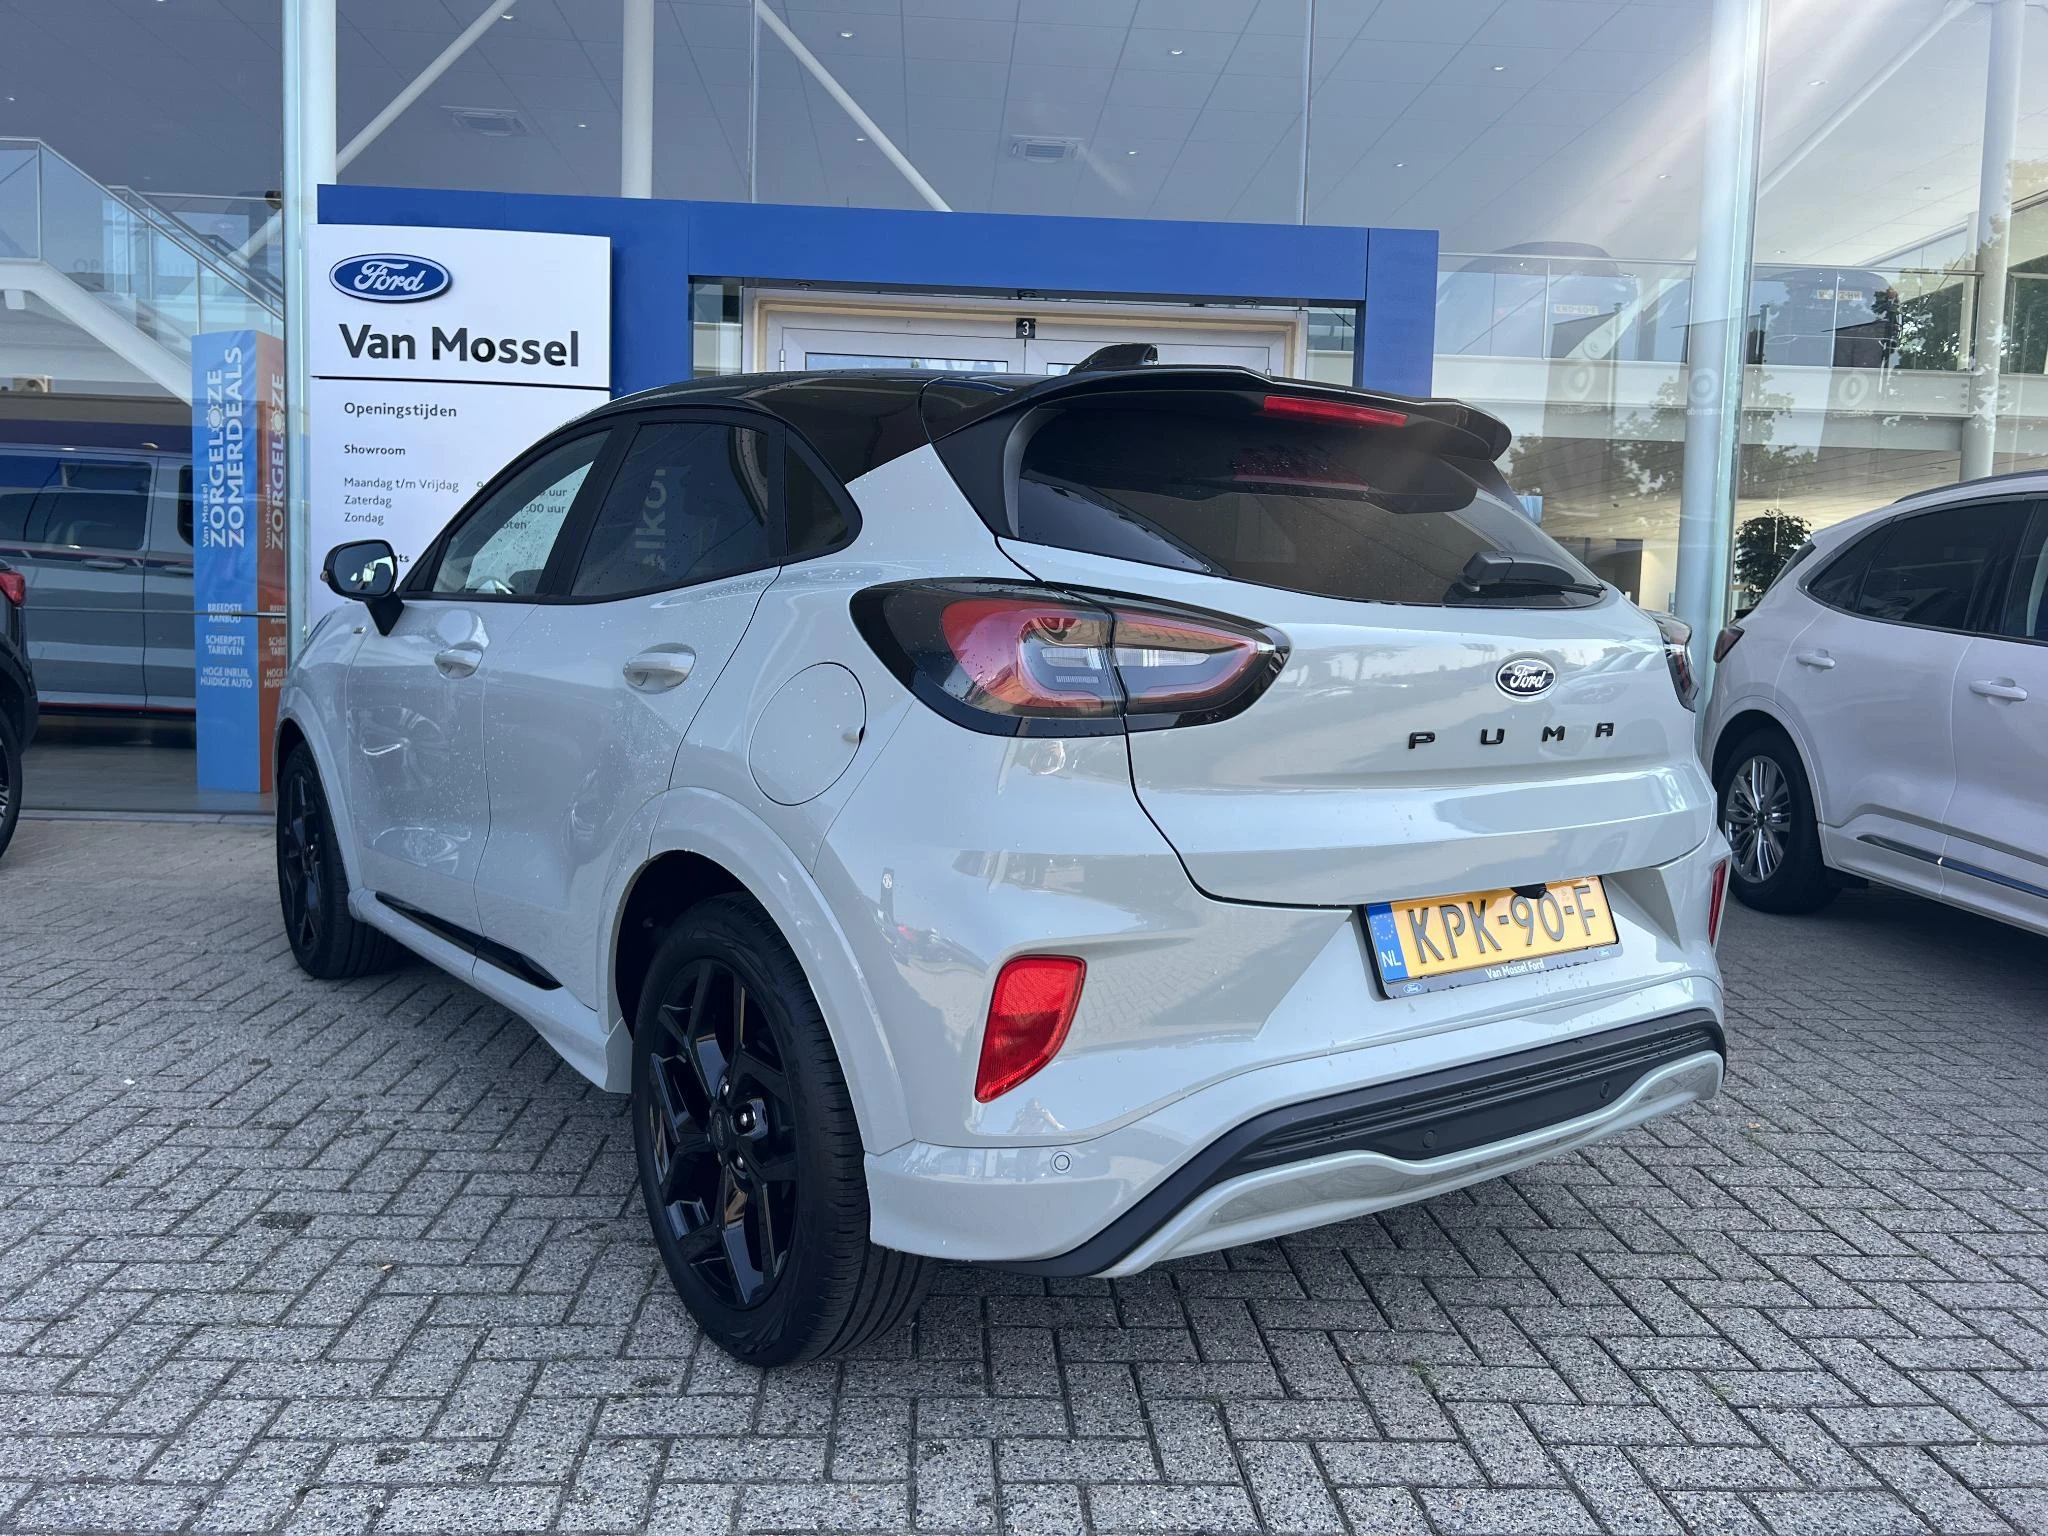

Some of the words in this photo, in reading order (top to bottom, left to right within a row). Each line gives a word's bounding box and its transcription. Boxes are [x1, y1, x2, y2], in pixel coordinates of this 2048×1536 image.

[354, 260, 425, 292] Ford
[1022, 321, 1029, 336] 3
[339, 324, 416, 360] Van
[432, 326, 579, 367] Mossel
[344, 402, 457, 419] Openingstijden
[225, 347, 245, 548] ZOMERDEALS
[344, 444, 406, 456] Showroom
[344, 477, 393, 490] Maandag
[395, 478, 417, 489] t/m
[419, 479, 459, 492] Vrijdag
[344, 495, 392, 508] Zaterdag
[344, 512, 384, 524] Zondag
[205, 635, 245, 647] SCHERPSTE
[208, 645, 243, 656] TARIEVEN
[231, 679, 253, 689] AUTO
[1510, 665, 1547, 689] Ford
[1408, 722, 1615, 749] PUMA
[1408, 884, 1596, 964] KPK-90-F
[1380, 950, 1402, 968] NL
[1485, 968, 1502, 979] Van
[1501, 961, 1529, 976] Mossel
[1527, 957, 1545, 971] Ford
